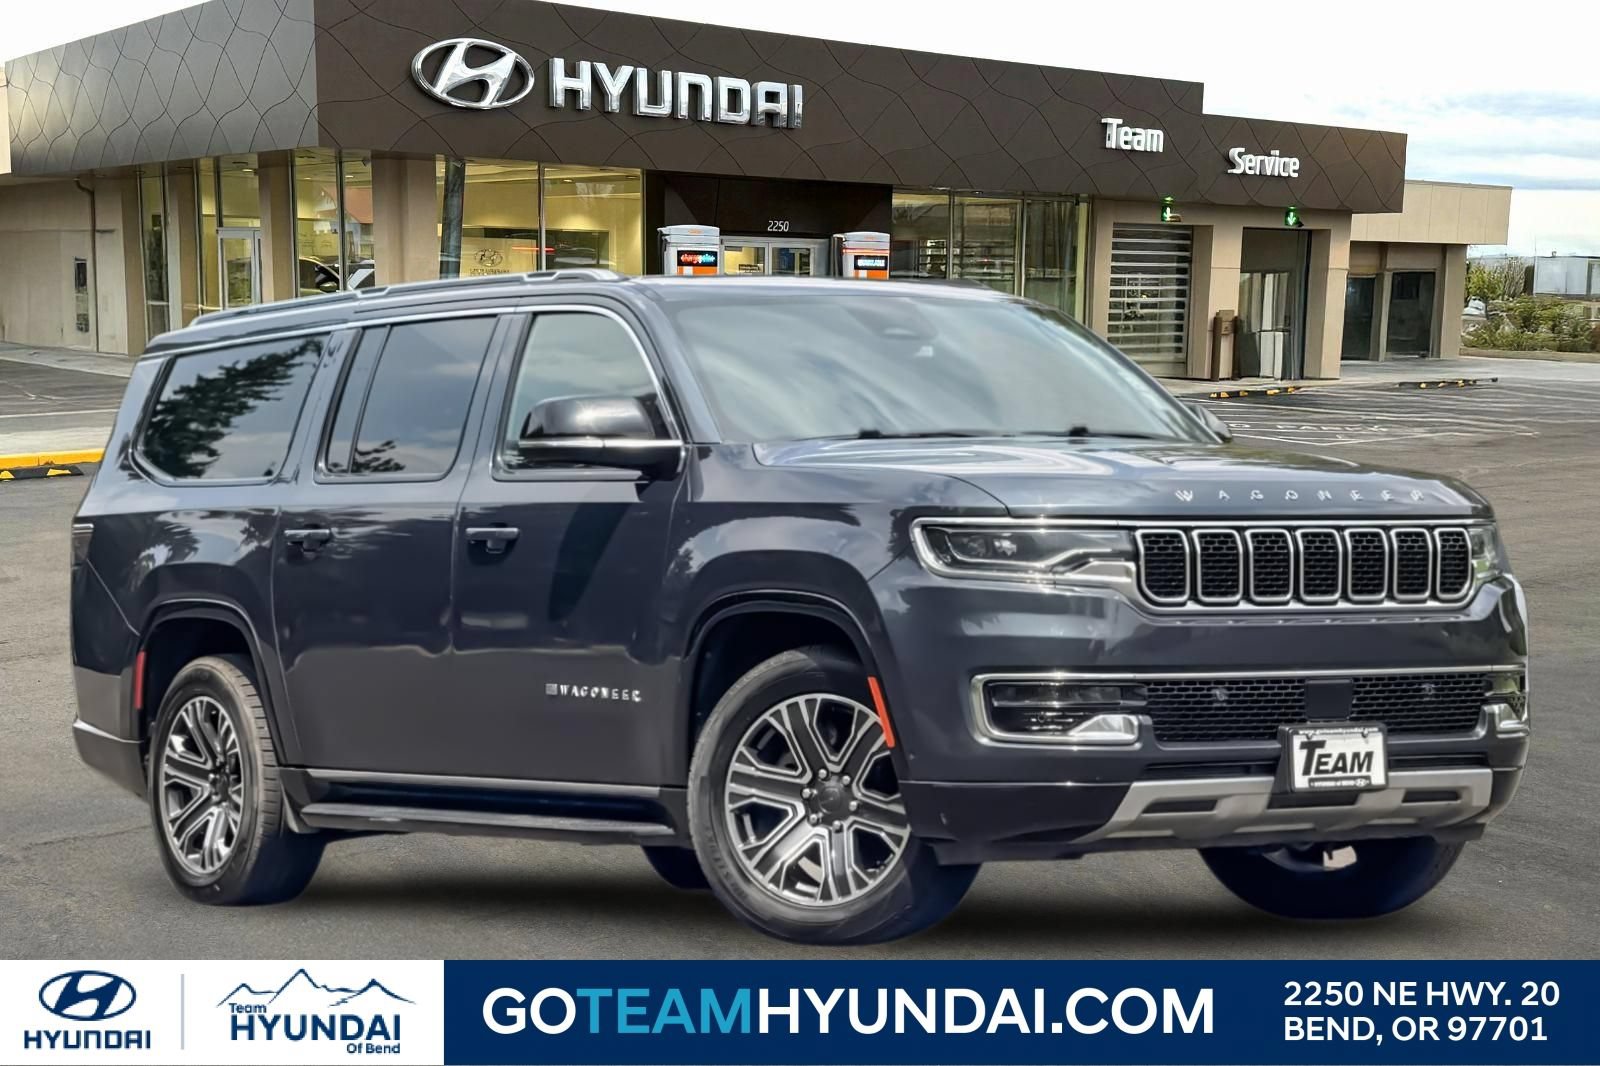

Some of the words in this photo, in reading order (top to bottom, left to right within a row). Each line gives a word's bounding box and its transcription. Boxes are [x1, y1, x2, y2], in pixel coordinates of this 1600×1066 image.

[549, 57, 803, 129] HYUNDAI
[1101, 117, 1164, 153] Team
[1227, 147, 1300, 178] Service
[767, 220, 790, 232] 2250
[1174, 489, 1425, 502] WAGONEER
[560, 684, 642, 702] WAGONEER
